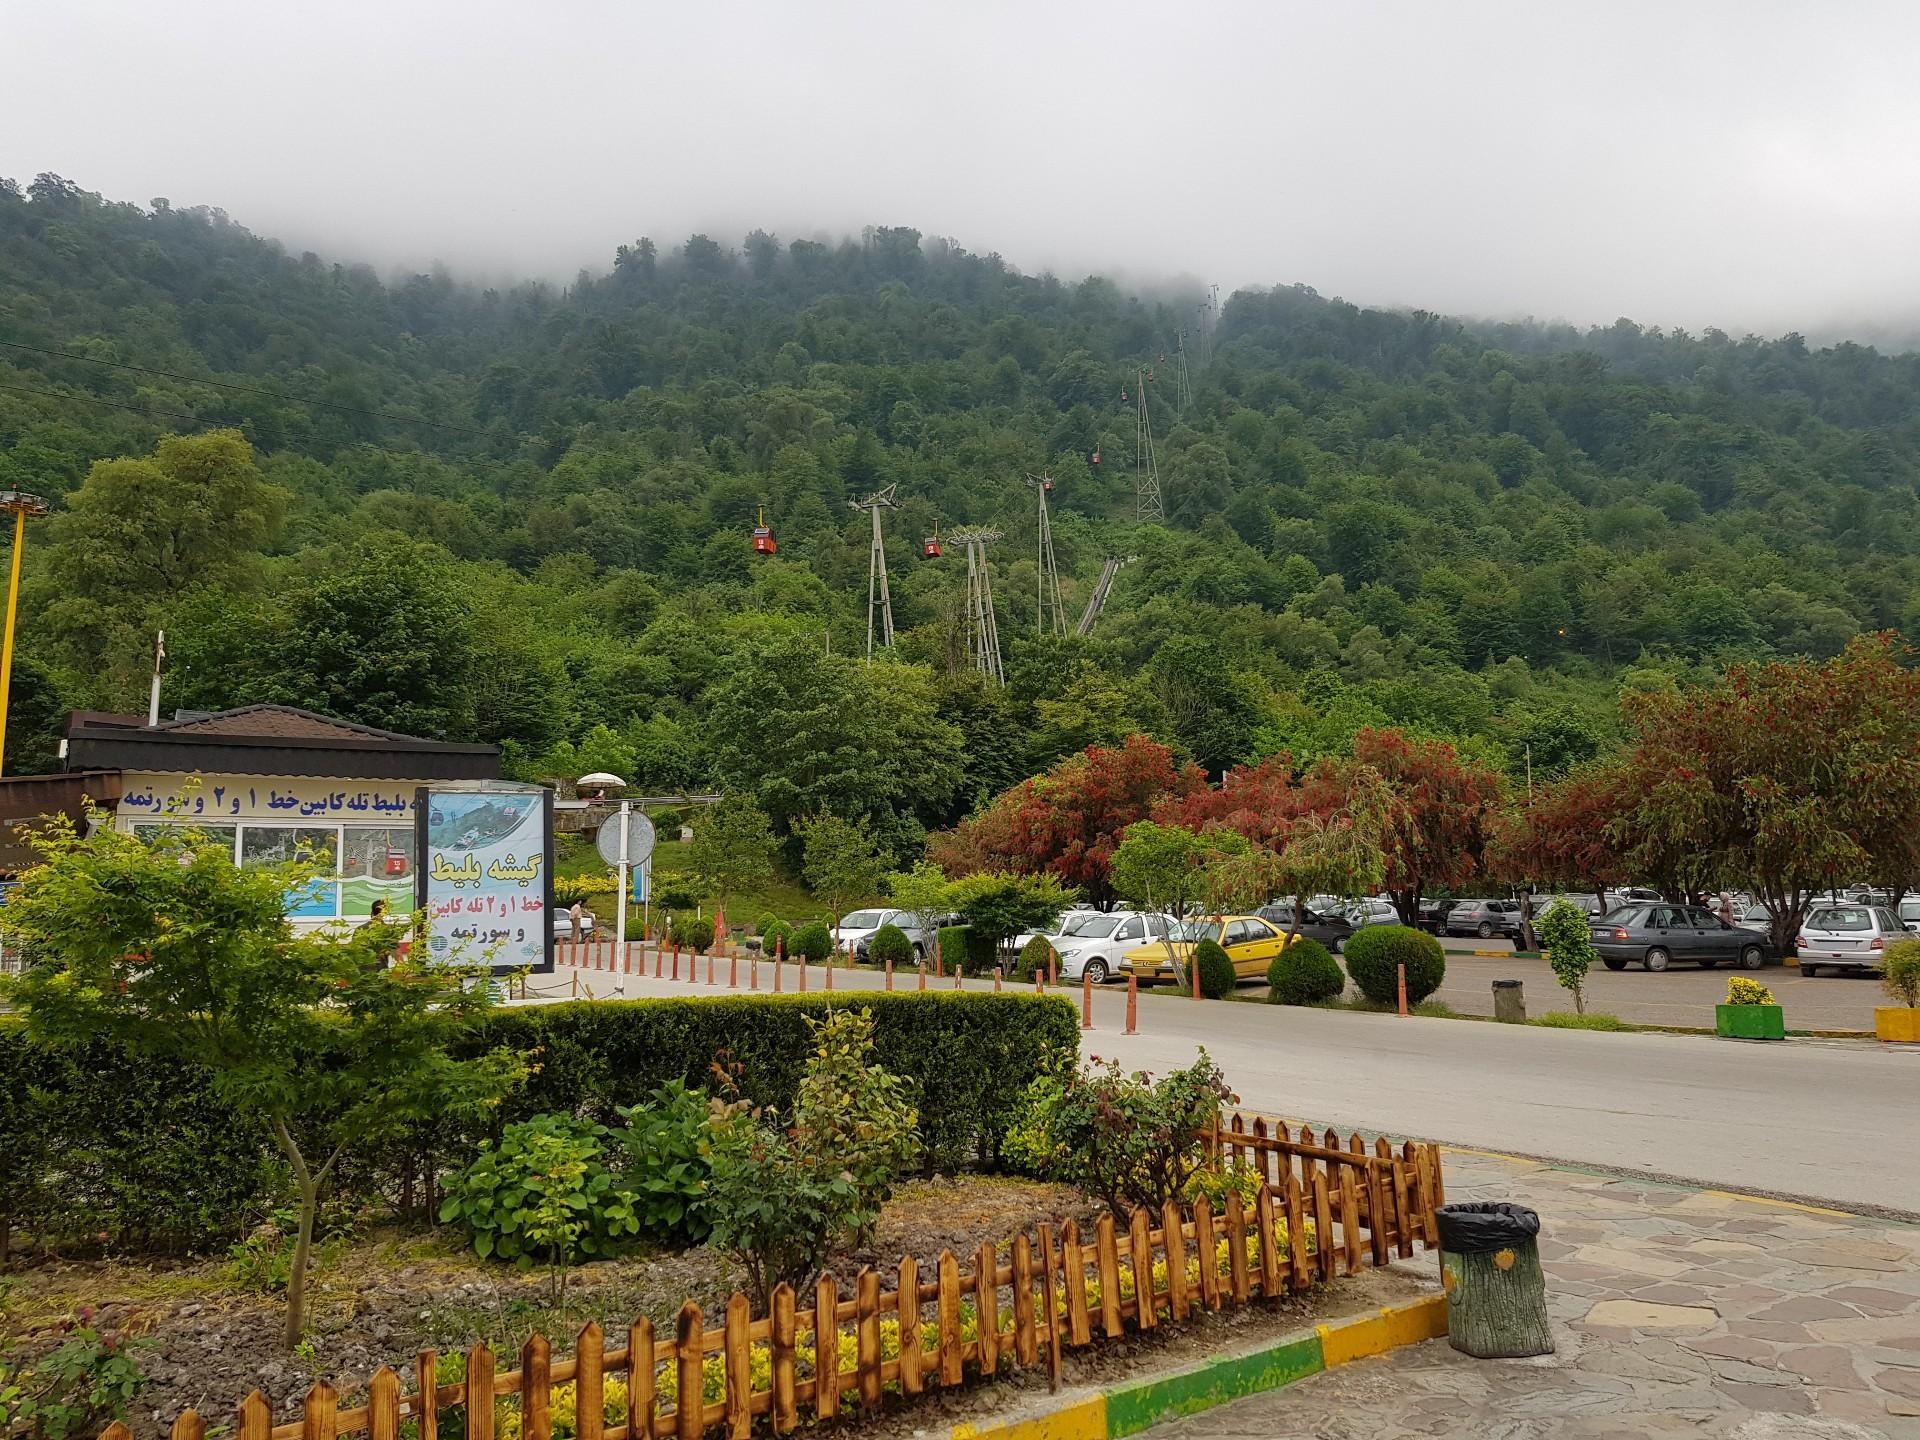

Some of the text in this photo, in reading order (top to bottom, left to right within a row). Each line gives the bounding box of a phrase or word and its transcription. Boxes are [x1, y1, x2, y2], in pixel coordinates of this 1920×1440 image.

[193, 796, 204, 813] و
[213, 786, 225, 808] ۲
[229, 797, 240, 814] و
[267, 790, 299, 809] خط
[300, 792, 346, 815] کابین
[347, 793, 369, 810] تله
[371, 793, 406, 816] بلیط
[430, 853, 542, 888] گیشه بلیط
[467, 897, 483, 913] تله
[487, 896, 495, 914] ۲
[499, 903, 507, 917] و
[521, 895, 544, 911] خط
[515, 928, 525, 943] و
